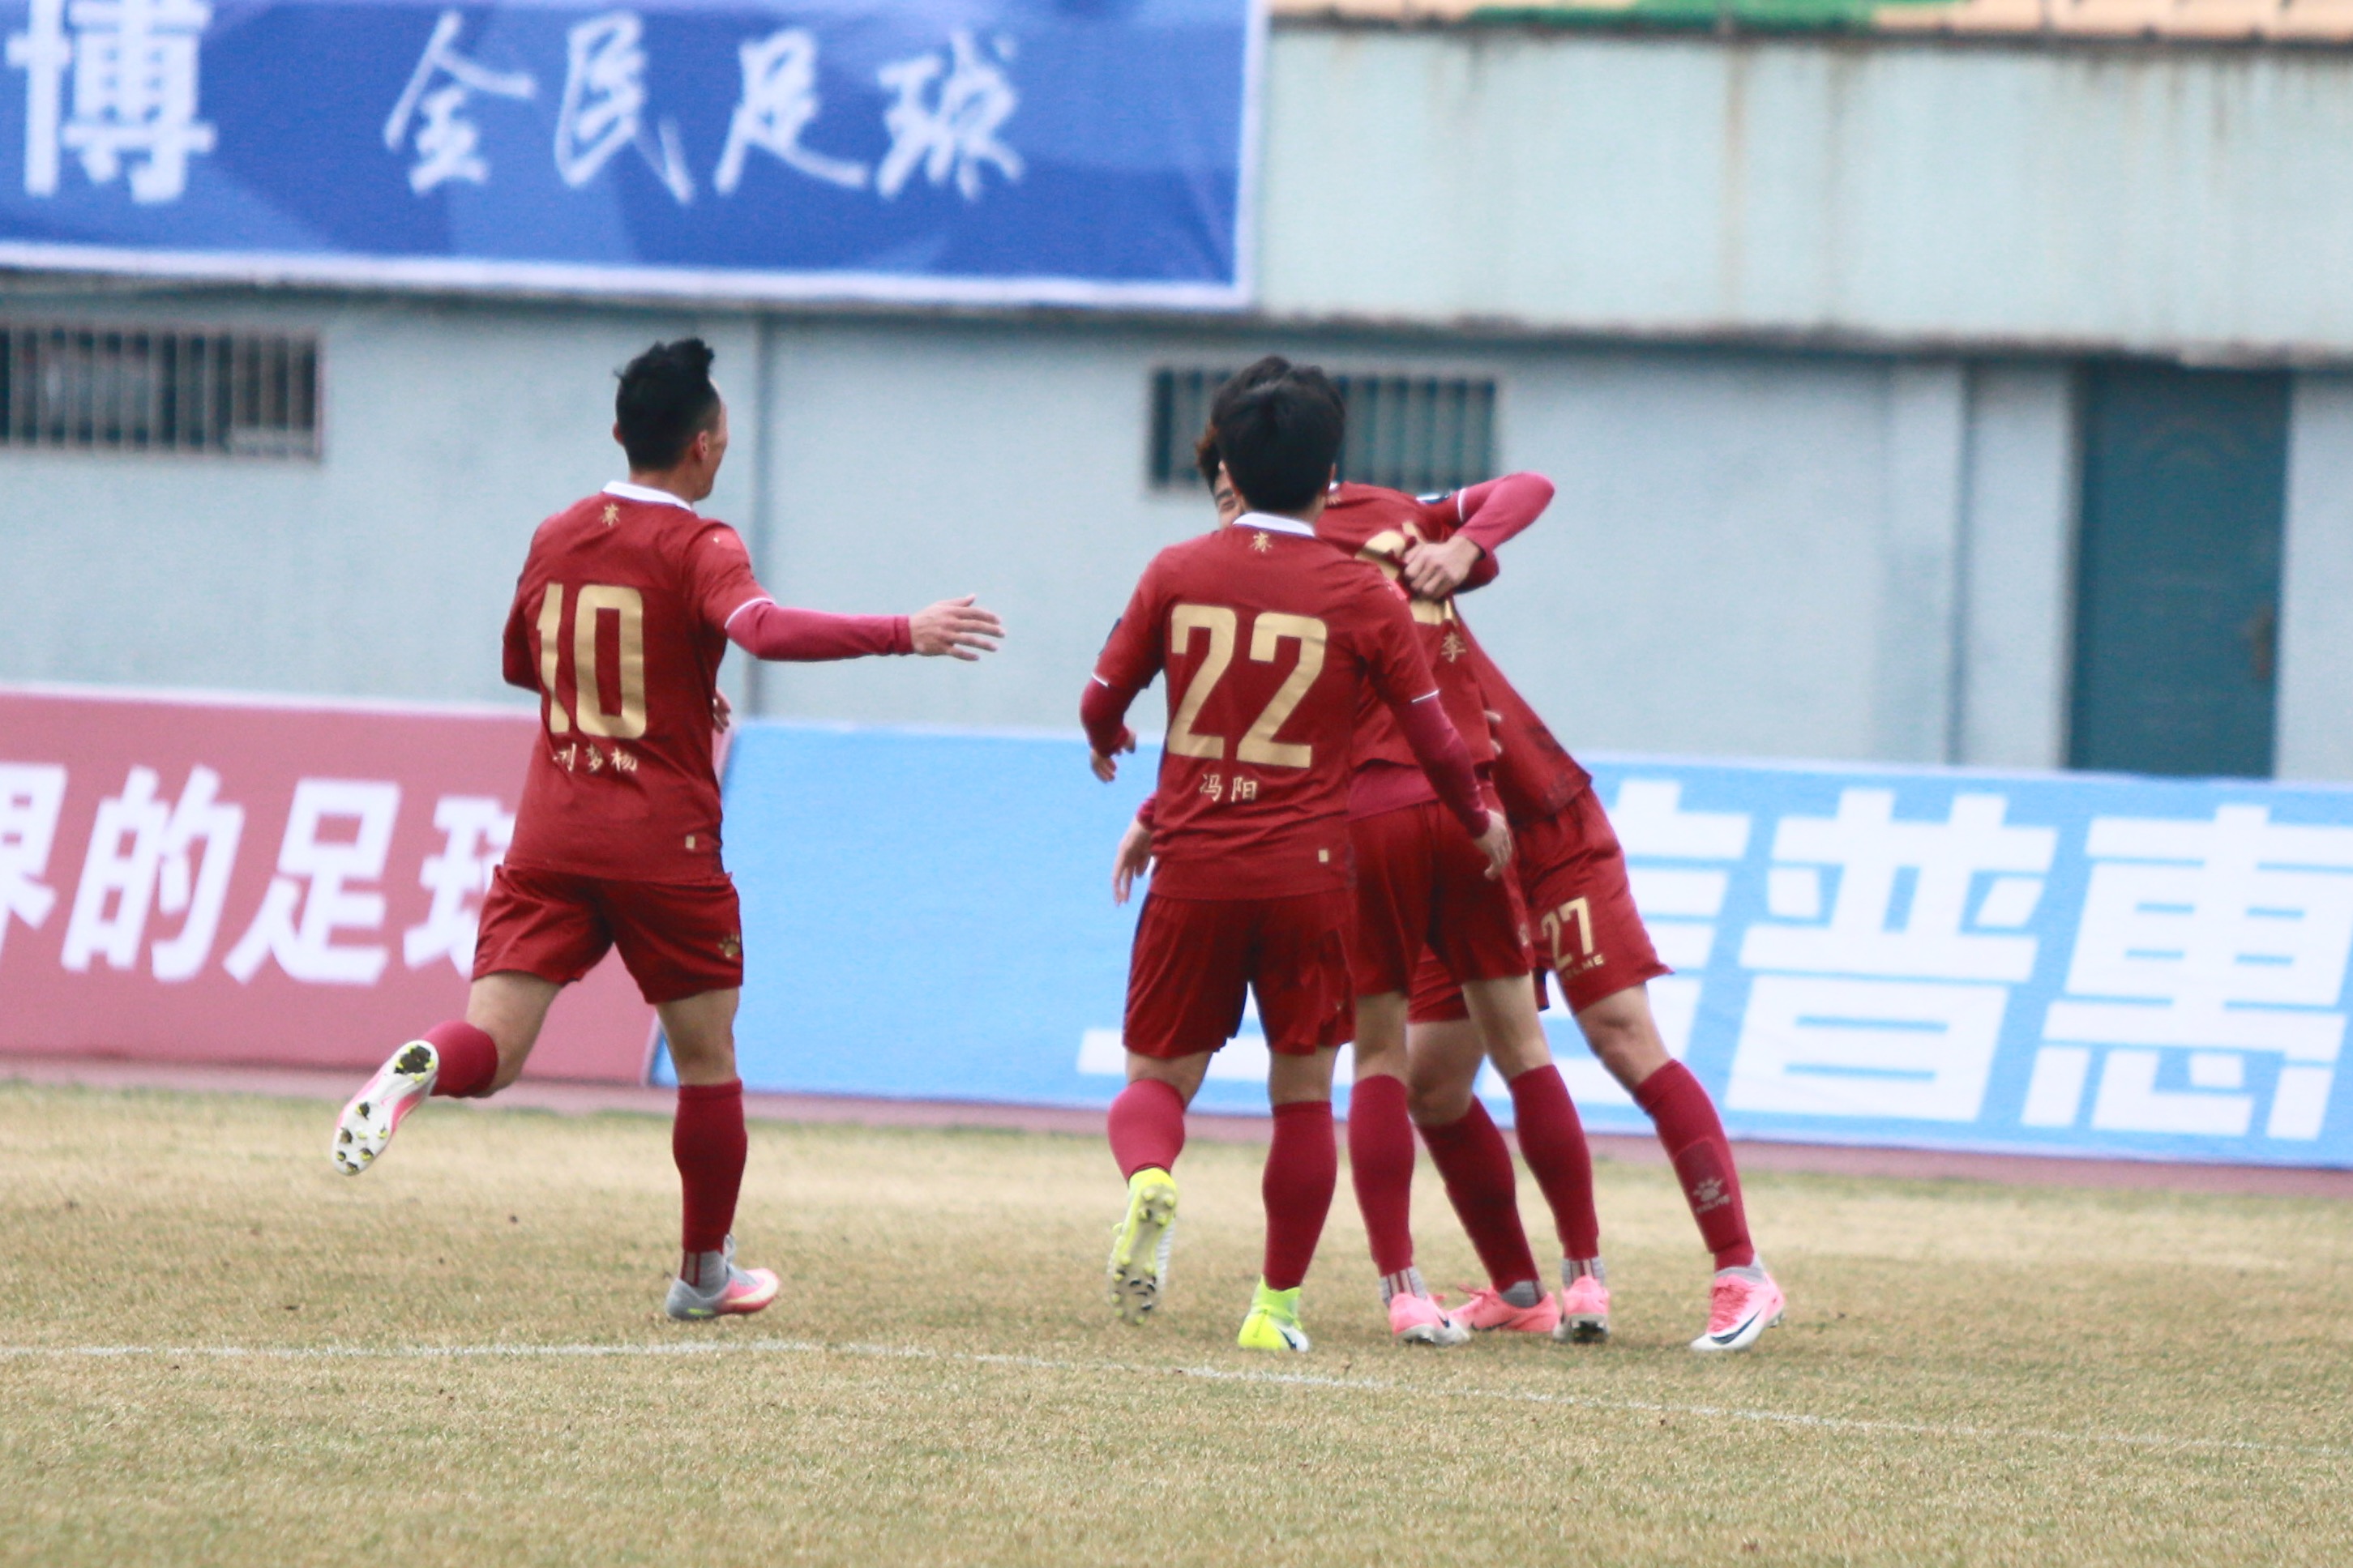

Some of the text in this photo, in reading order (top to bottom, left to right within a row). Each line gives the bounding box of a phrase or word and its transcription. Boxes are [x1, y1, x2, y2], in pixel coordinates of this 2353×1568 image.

[5, 0, 1026, 206] 博 全民足球
[536, 583, 648, 739] 10
[1166, 603, 1328, 769] 22
[1199, 773, 1258, 803] 冯阳
[1540, 895, 1594, 972] 27
